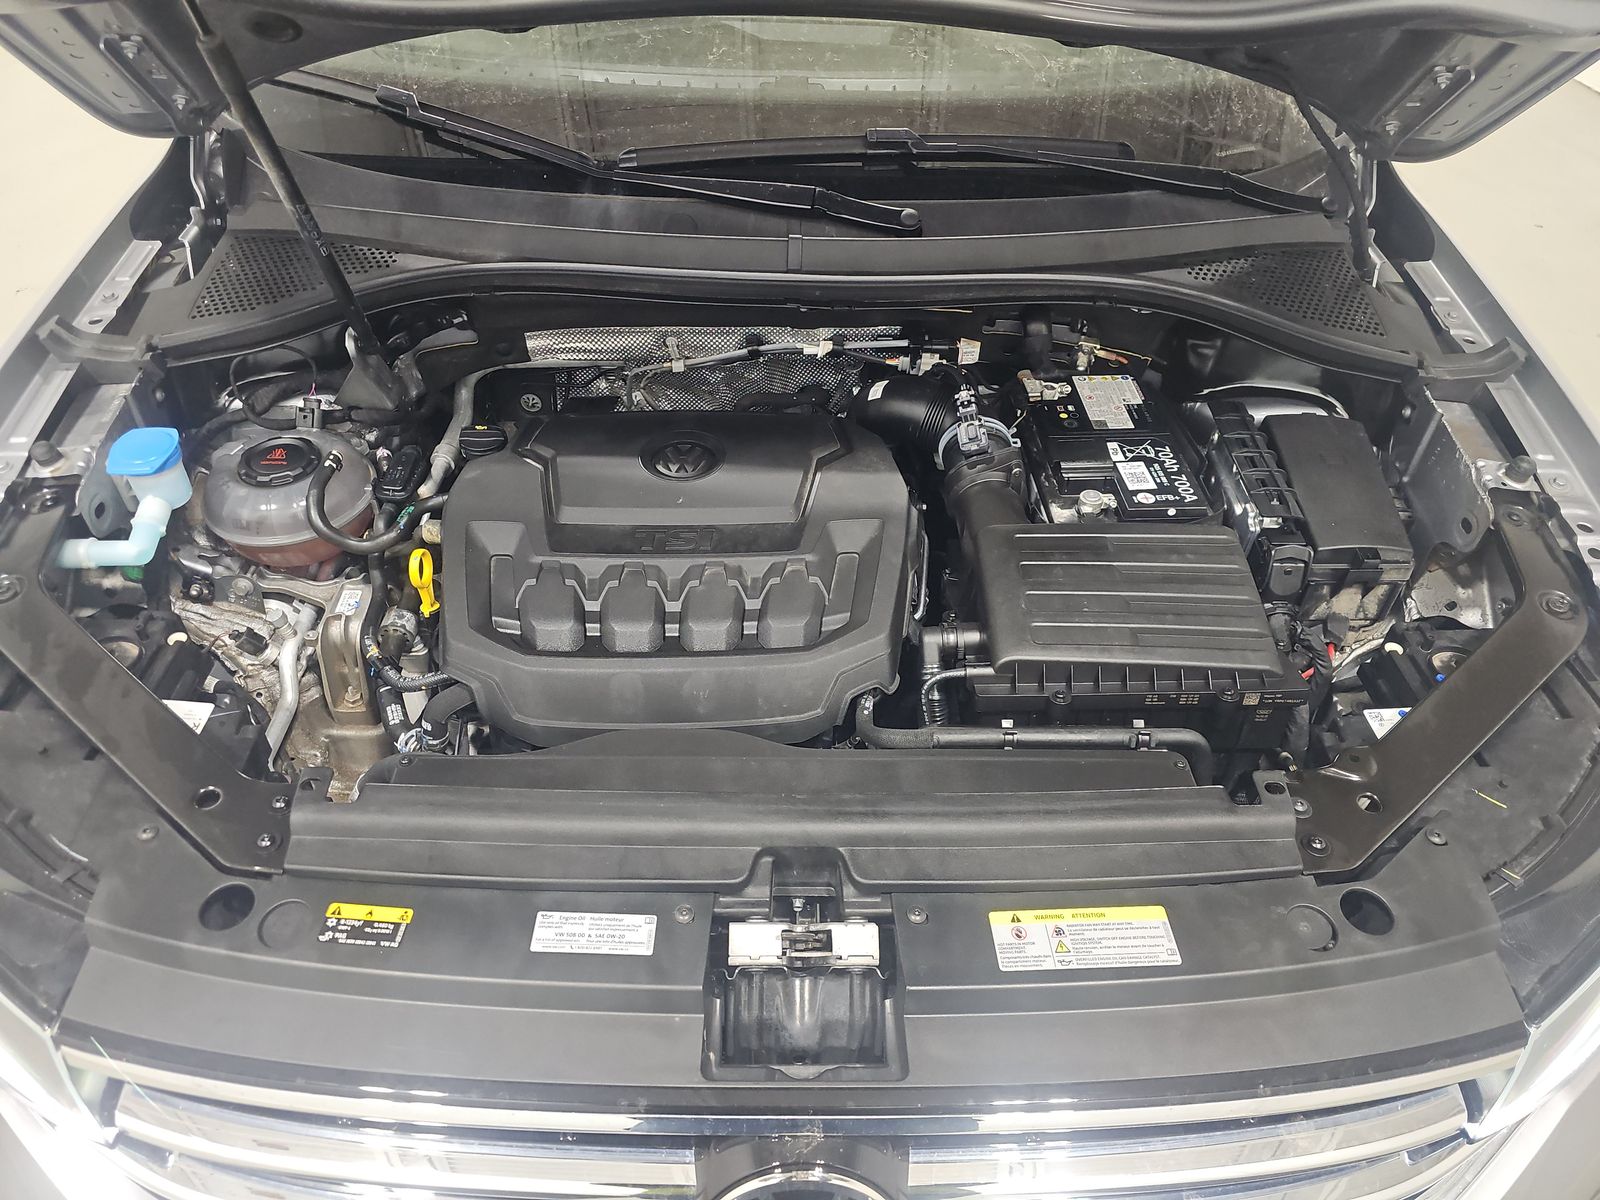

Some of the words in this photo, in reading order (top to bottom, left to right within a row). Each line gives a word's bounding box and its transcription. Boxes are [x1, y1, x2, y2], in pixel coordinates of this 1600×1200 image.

[1110, 447, 1119, 456] Pb
[1154, 445, 1180, 472] 70Ah
[1170, 473, 1198, 503] 700A
[635, 528, 717, 551] TSI
[1033, 913, 1065, 921] WARNING
